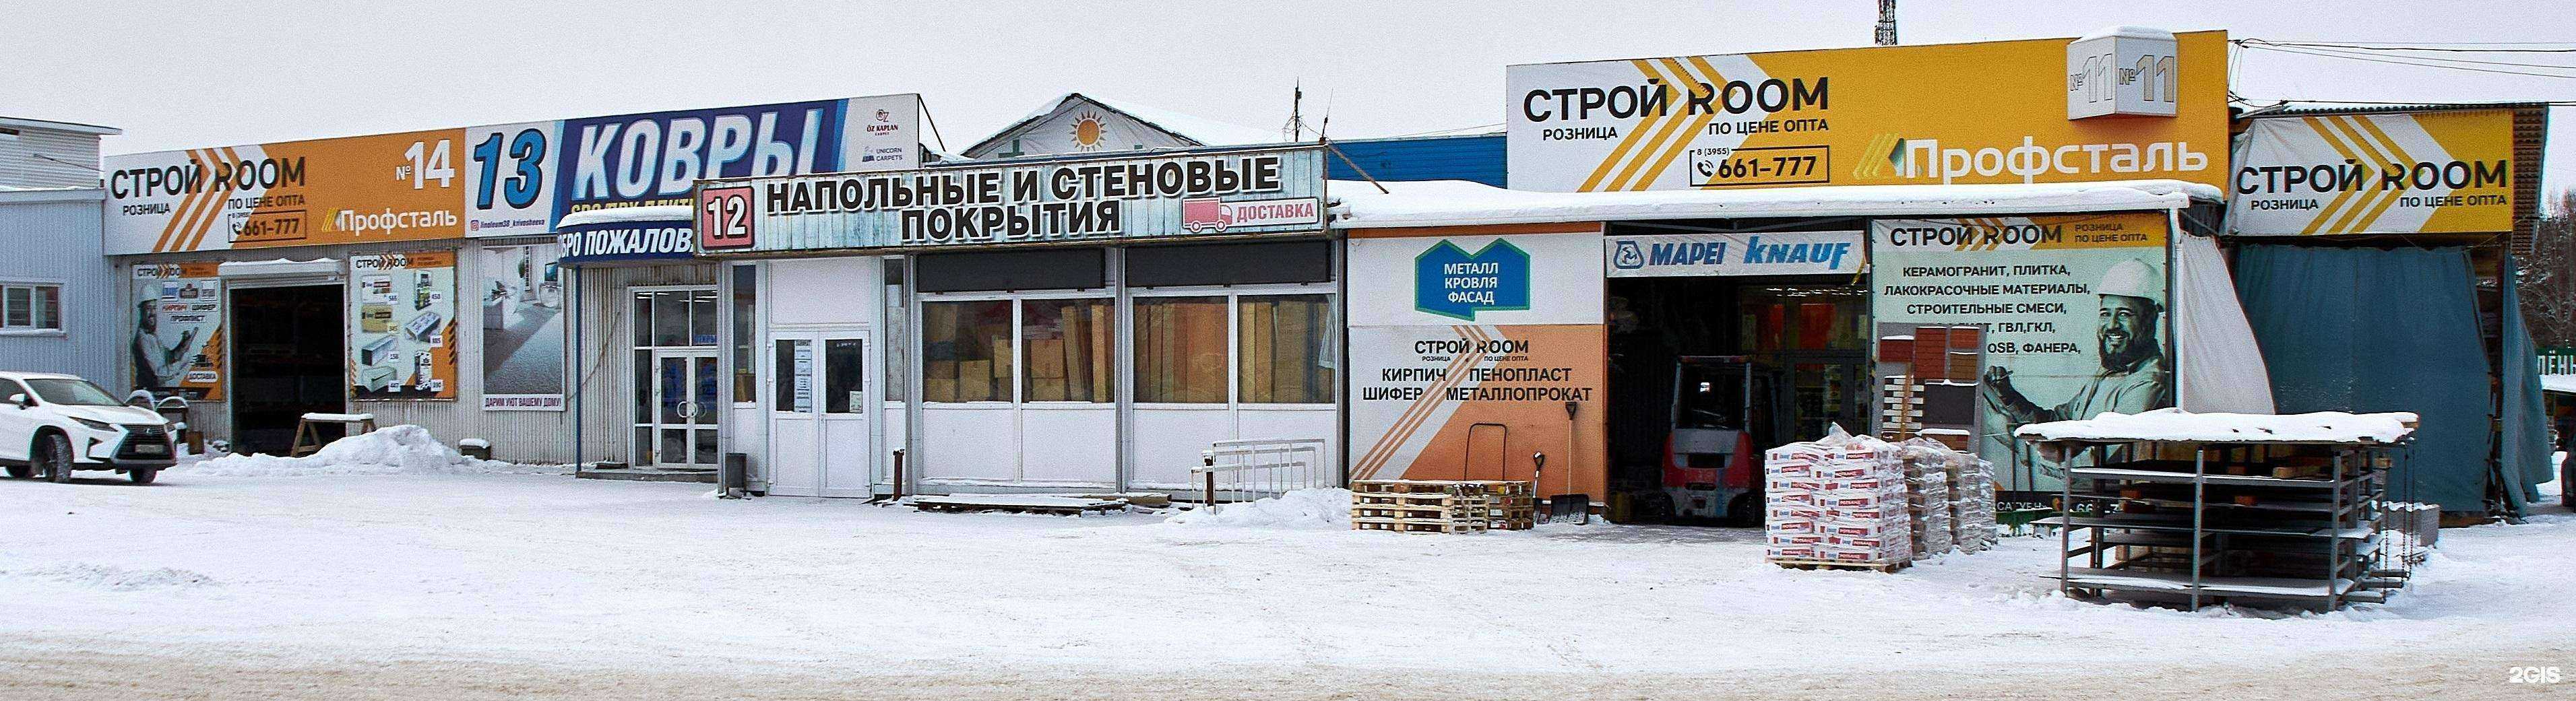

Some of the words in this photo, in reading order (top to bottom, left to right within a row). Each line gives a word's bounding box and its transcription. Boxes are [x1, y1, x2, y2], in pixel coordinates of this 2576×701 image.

[2119, 54, 2176, 103] №11
[1523, 77, 1667, 123] СТРОЙ
[1688, 76, 1829, 116] ROOM
[1542, 126, 1619, 141] РОЗНИЦА
[1708, 123, 1732, 135] ПО
[1736, 121, 1778, 136] ЦЕНЕ
[1784, 119, 1829, 133] ОПТА
[571, 108, 823, 200] КОВРЫ
[1704, 147, 1730, 157] (3955)
[1906, 135, 2209, 184] Профсталь
[396, 139, 455, 190] №14
[473, 128, 546, 210] 13
[1718, 156, 1817, 178] 661-777
[111, 159, 202, 200] СТРОЙ
[215, 156, 305, 193] ROOM
[765, 170, 999, 213] НАПОЛЬНЫЕ
[1013, 169, 1038, 201] И
[1051, 157, 1279, 197] СТЕНОВЫЕ
[2236, 158, 2364, 195] СТРОЙ
[2381, 160, 2507, 193] ROOM
[123, 203, 170, 217] РОЗНИЦА
[228, 199, 243, 210] ПО
[245, 196, 273, 210] ЦЕНЕ
[276, 194, 305, 207] ОПТА
[2251, 199, 2319, 211] РОЗНИЦА
[2399, 197, 2420, 208] ПО
[2424, 195, 2463, 209] ЦЕНЕ
[2467, 194, 2507, 207] ОПТА
[706, 193, 748, 239] 12
[902, 199, 1120, 241] ПОКРЫТИЯ
[1237, 203, 1315, 223] ДОСТАВКА
[244, 218, 300, 236] 661-777
[340, 208, 458, 237] Профсталь
[2075, 223, 2124, 232] РОЗНИЦА
[584, 228, 694, 256] ПОЖАЛОВ
[1984, 224, 2061, 244] ROOM
[2075, 234, 2089, 243] ПО
[2091, 234, 2118, 244] ЦЕНЕ
[2120, 233, 2148, 242] ОПТА
[1649, 242, 1726, 265] MAPEI
[1443, 261, 1499, 275] МЕТАЛЛ
[1902, 265, 2010, 277] КЕРАМОГРАНИТ,
[2013, 265, 2071, 277] ПЛИТКА,
[1444, 276, 1499, 290] КРОВЛЯ
[1884, 285, 1999, 296] ЛАКОКРАСОЧНЫЕ
[2003, 283, 2091, 296] МАТЕРИАЛЫ,
[1448, 291, 1495, 306] ФАСАД
[1906, 303, 2013, 314] СТРОИТЕЛЬНЫЕ
[2016, 302, 2067, 315] СМЕСИ,
[1415, 337, 1470, 354] СТРОЙ
[1476, 339, 1529, 354] ROOM
[1988, 342, 2019, 354] OSB,
[2022, 342, 2081, 354] ФАНЕРА,
[1381, 368, 1447, 385] КИРПИЧ
[1469, 368, 1571, 383] ПЕНОПЛАСТ
[1362, 386, 1423, 403] ШИФЕР
[1445, 386, 1592, 403] МЕТАЛЛОПРОКАТ
